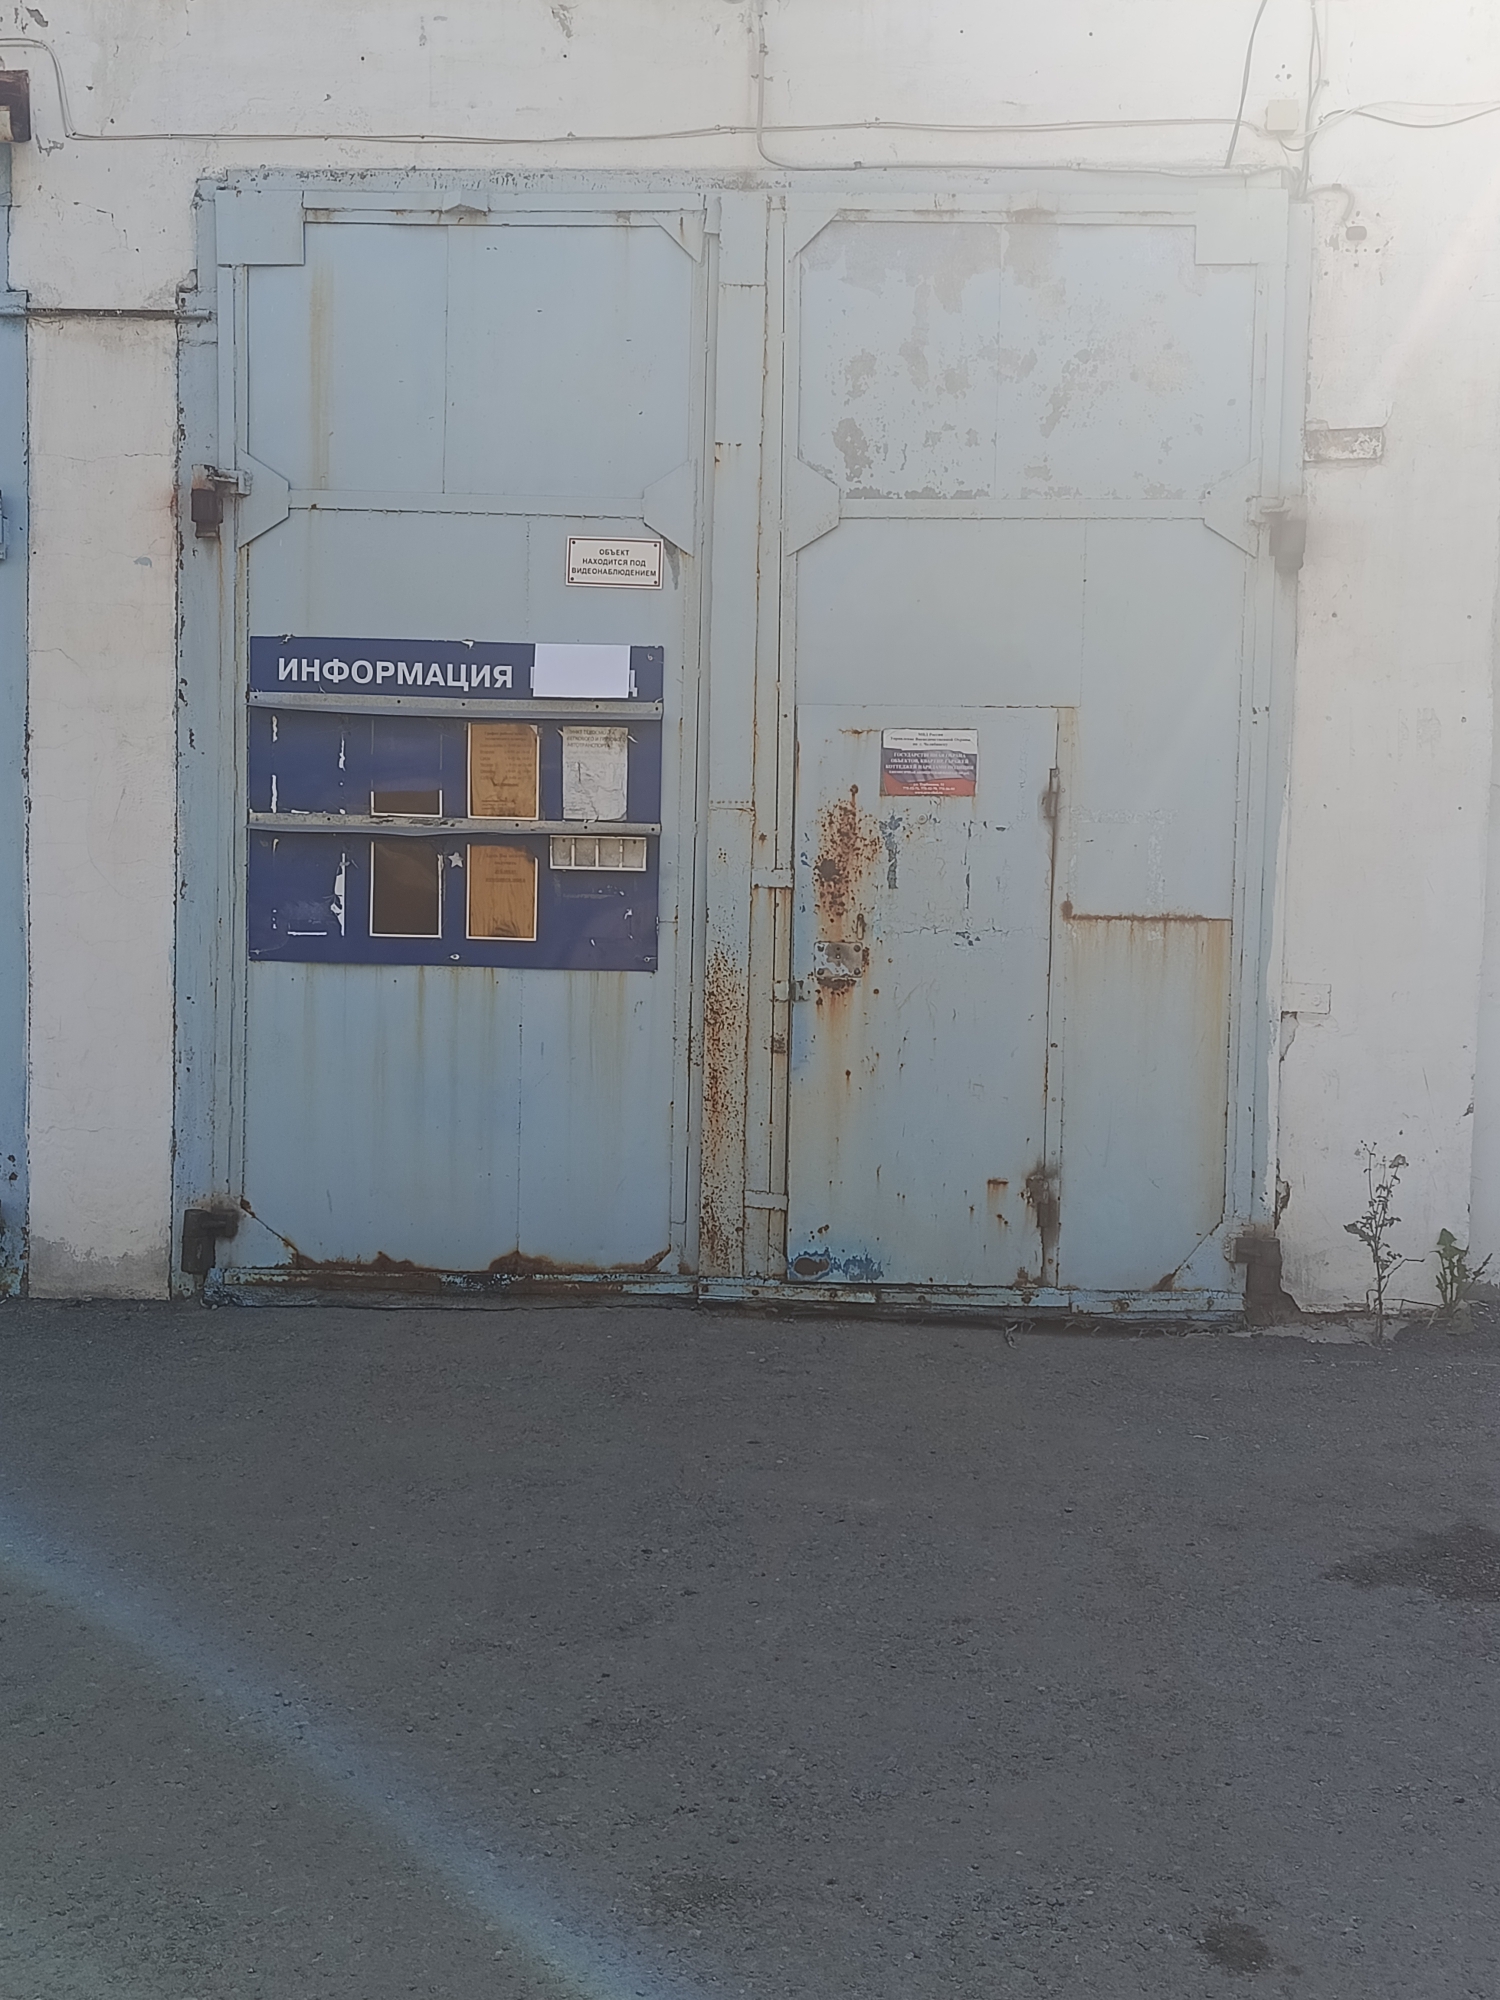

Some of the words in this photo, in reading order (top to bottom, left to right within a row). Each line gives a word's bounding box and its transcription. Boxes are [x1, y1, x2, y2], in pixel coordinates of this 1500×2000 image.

[582, 558, 628, 566] НАХОДИТСЯ
[571, 567, 657, 577] ВИДЕОНАБЛЮДЕНИЕМ
[278, 657, 513, 692] ИНФОРМАЦИЯ
